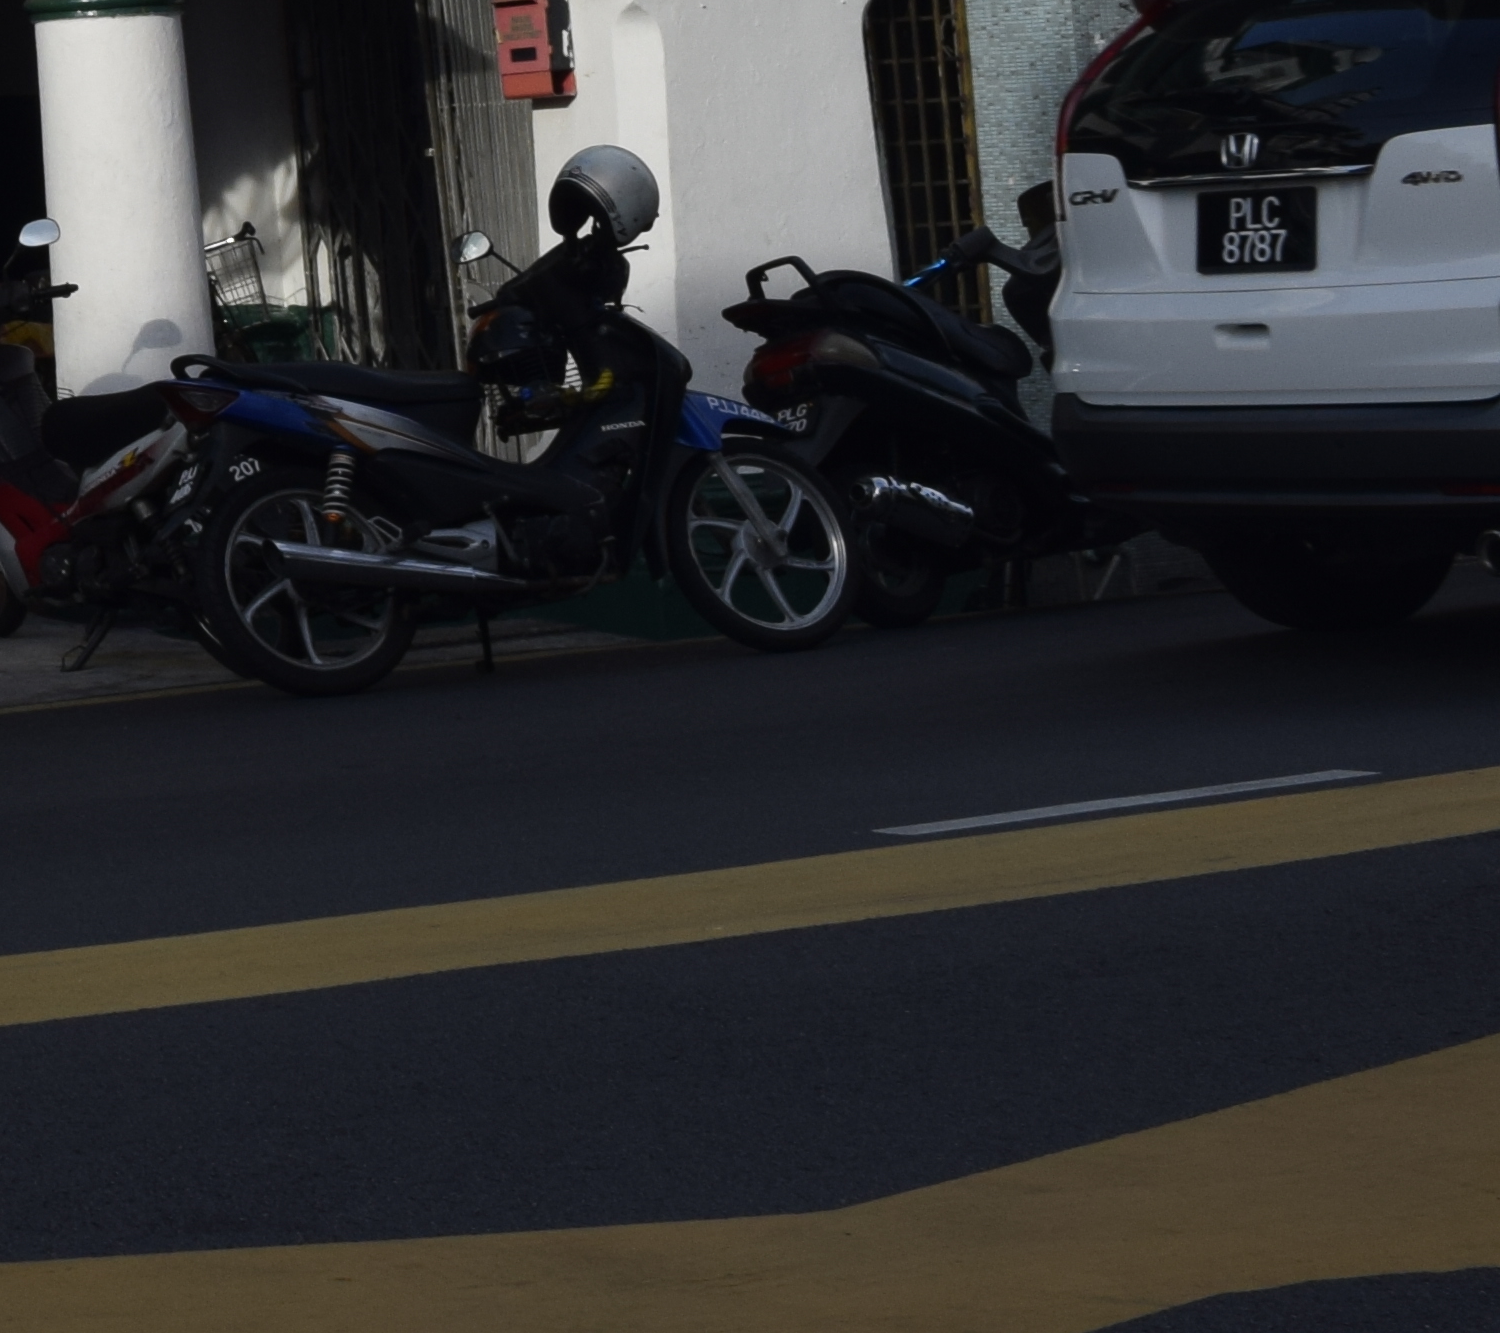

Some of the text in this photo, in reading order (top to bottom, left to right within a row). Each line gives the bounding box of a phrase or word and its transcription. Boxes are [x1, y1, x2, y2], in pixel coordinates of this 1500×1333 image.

[1229, 195, 1280, 230] PLC
[1222, 229, 1288, 264] 8787
[601, 419, 646, 432] HONDA
